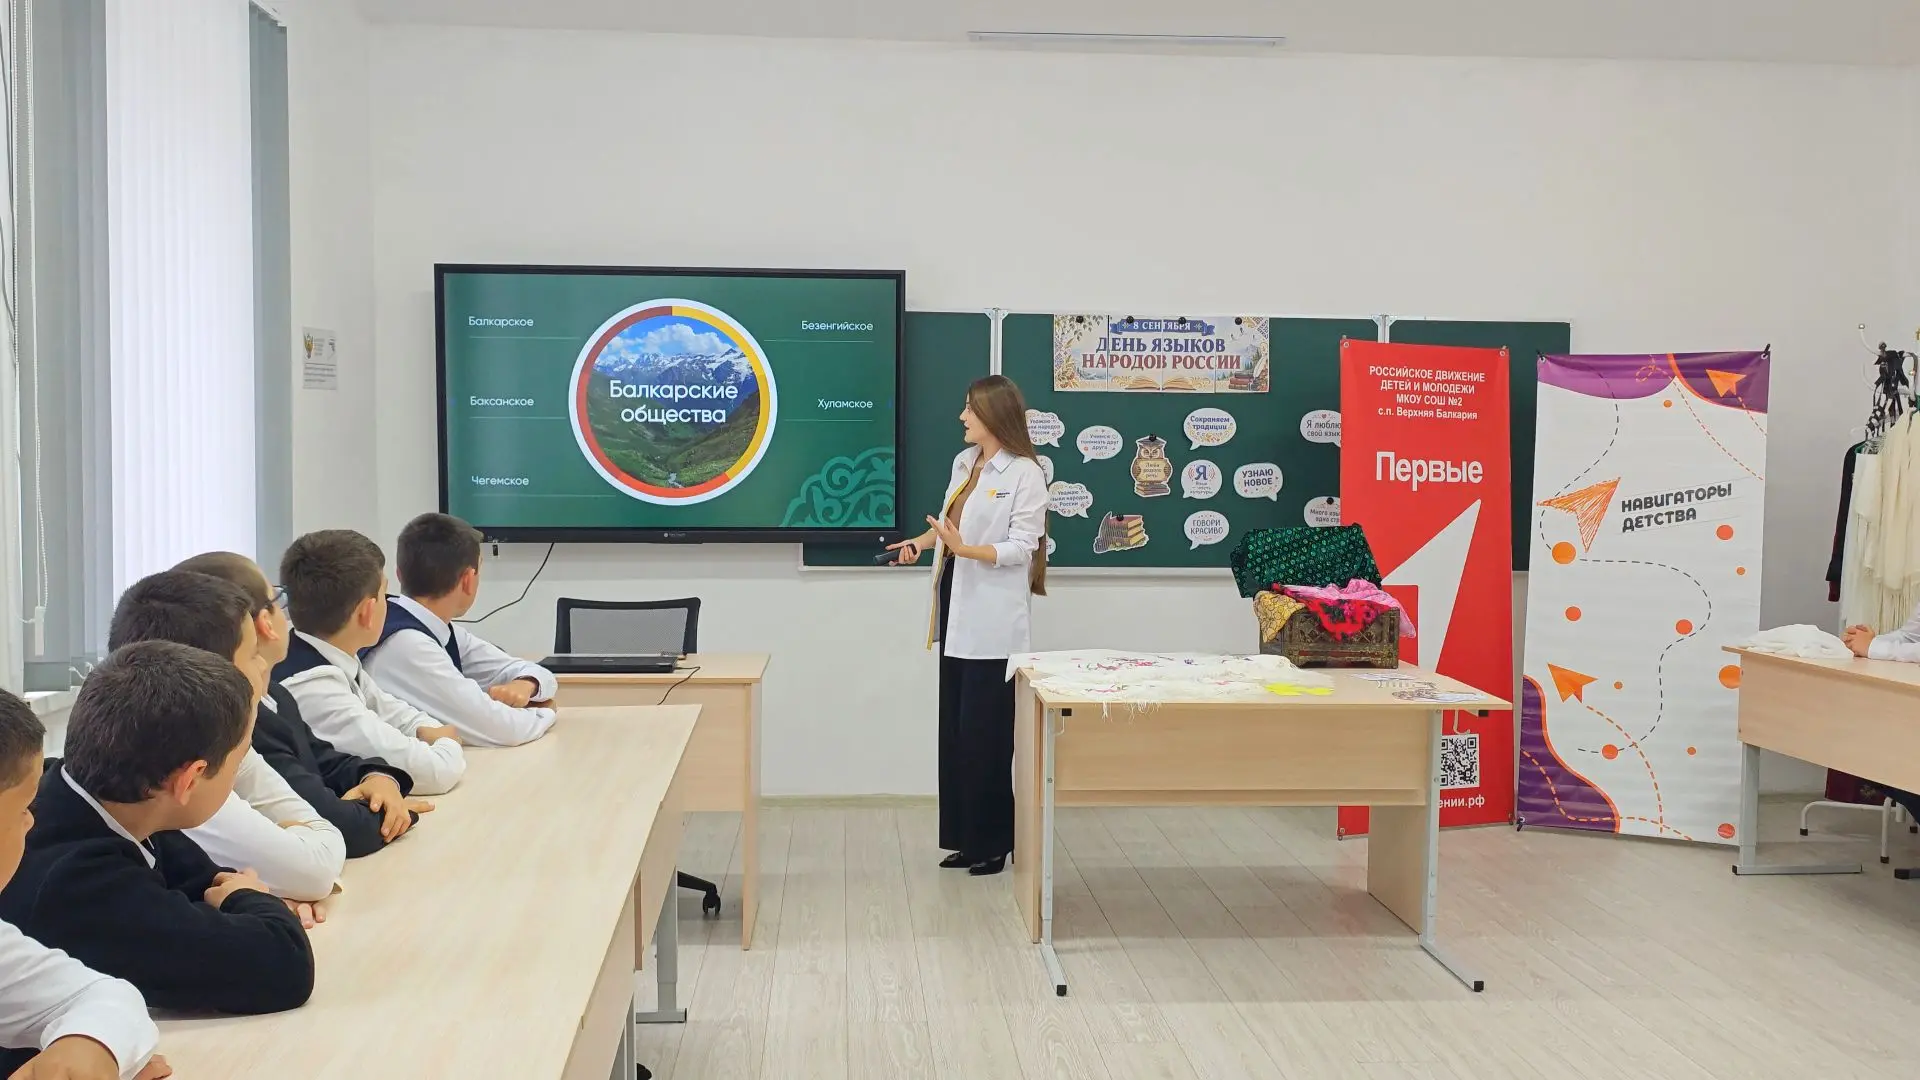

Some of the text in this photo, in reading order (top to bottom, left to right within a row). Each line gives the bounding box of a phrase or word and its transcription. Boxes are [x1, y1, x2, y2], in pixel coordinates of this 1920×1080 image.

[468, 315, 535, 329] Балкарское
[801, 320, 874, 331] Безенгийское
[1133, 320, 1191, 331] 8 СЕНТЯБРЯ
[1095, 337, 1226, 354] ДЕНЬ ЯЗЫКОВ
[1082, 353, 1241, 371] НАРОДОВ РОССИИ
[1369, 365, 1486, 382] РОССИЙСКОЕ ДВИЖЕНИЕ
[609, 379, 739, 402] Балкарские
[1380, 379, 1475, 394] ДЕТЕЙ И МОЛОДЕЖИ
[470, 395, 535, 406] Баксанское
[817, 398, 874, 410] Хуламское
[1396, 394, 1463, 406] МКОУ СОШ №2
[620, 404, 726, 425] общества
[1190, 415, 1230, 424] Сохраняем
[1378, 407, 1478, 421] с.п. Верхняя Балкария
[1306, 419, 1312, 428] Я
[1242, 468, 1274, 479] УЗНАЮ
[1376, 451, 1483, 491] Первые
[471, 475, 530, 486] Чегемское
[1243, 477, 1273, 487] НОВОЕ
[1621, 483, 1732, 512] НАВИГАТОРЫ
[1192, 519, 1221, 527] ГОВОРИ
[1622, 507, 1697, 533] ДЕТСТВА
[1190, 527, 1224, 535] КРАСИВО
